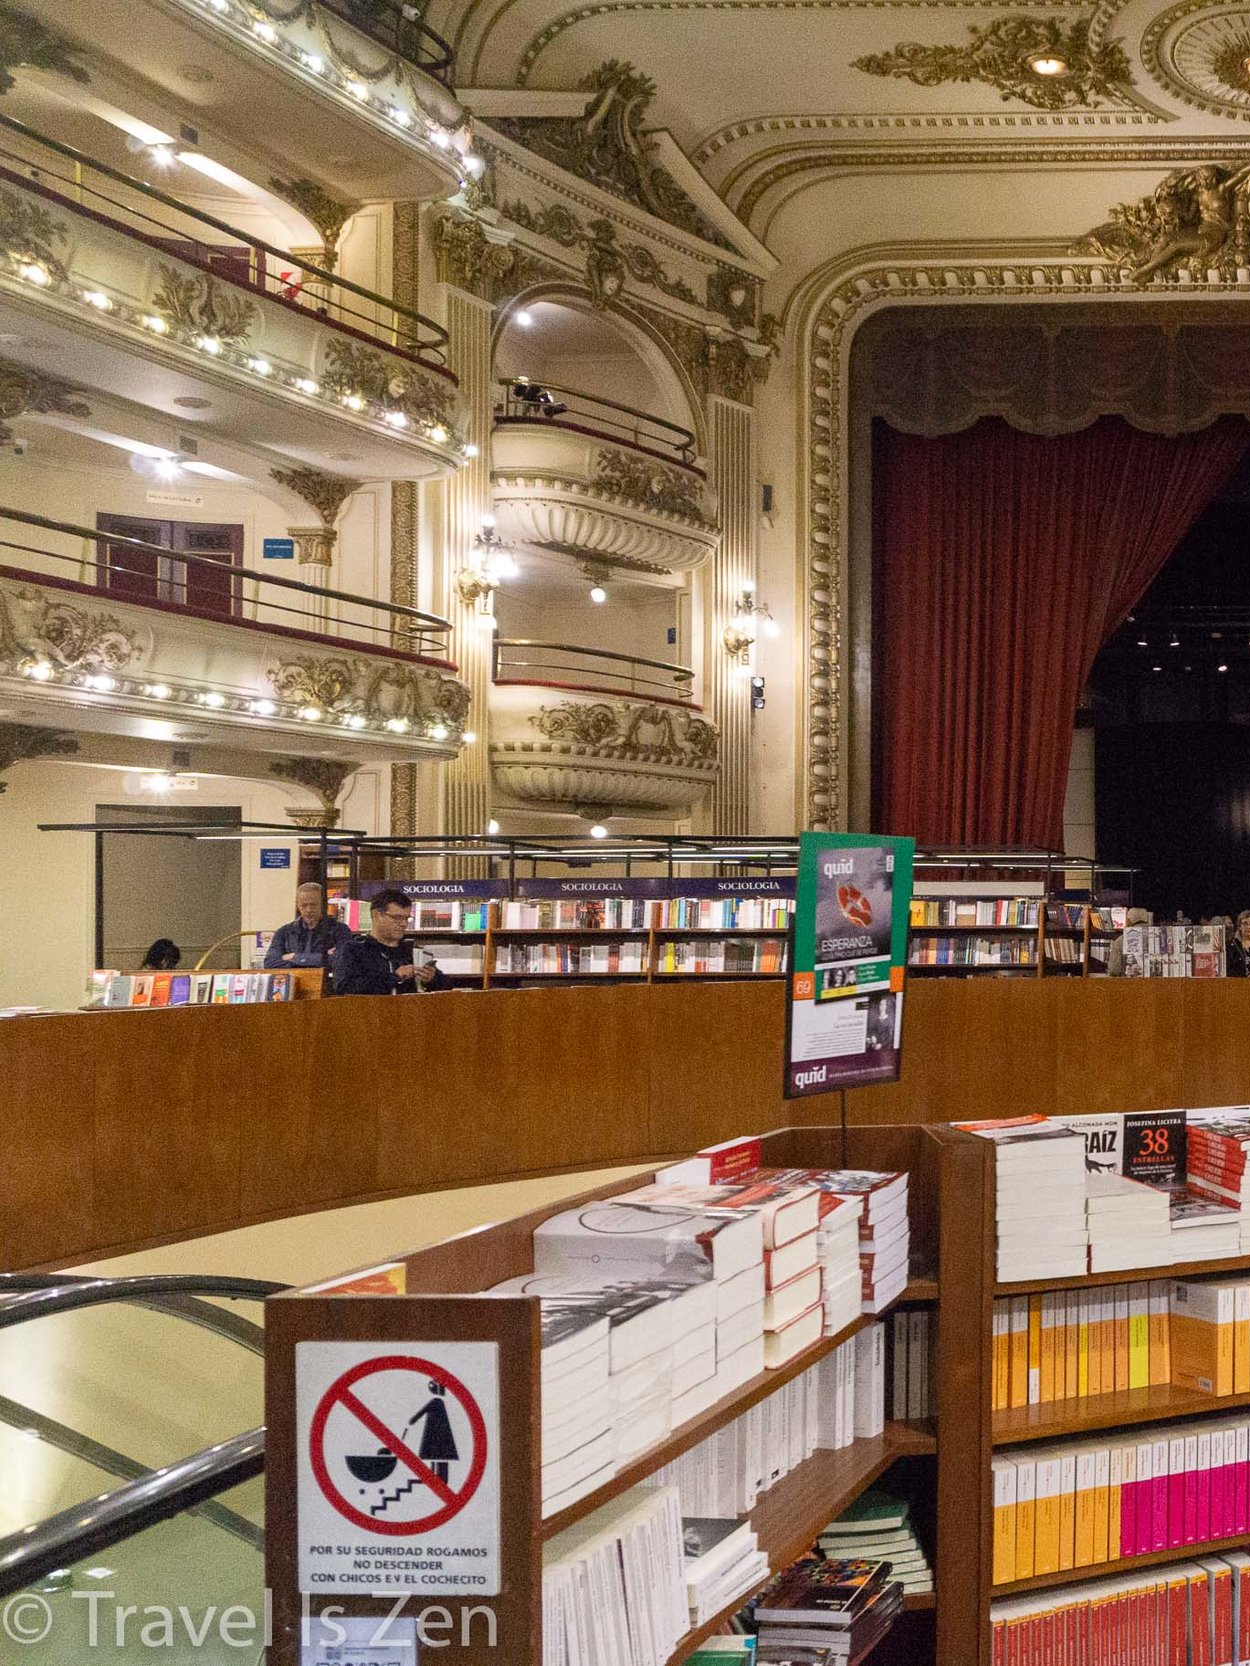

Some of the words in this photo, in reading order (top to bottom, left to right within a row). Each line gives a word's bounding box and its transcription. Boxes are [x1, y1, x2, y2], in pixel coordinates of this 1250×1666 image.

[823, 858, 854, 879] quid
[403, 884, 465, 894] SOCIOLOGIA
[561, 882, 623, 892] SOCIOLOGIA
[718, 881, 780, 891] SOCIOLOGIA
[821, 935, 873, 953] ESPERANZA
[795, 1065, 827, 1089] quid
[1139, 1128, 1169, 1156] 38
[309, 1545, 333, 1556] POR
[337, 1545, 352, 1556] SU
[355, 1546, 423, 1557] SEGURIDAD
[426, 1547, 488, 1558] ROGAMOS
[353, 1560, 371, 1570] NO
[374, 1560, 443, 1571] DESCENDER
[311, 1573, 336, 1584] CON
[339, 1573, 382, 1584] CHICOS
[404, 1575, 418, 1584] EL
[421, 1574, 487, 1585] COCHECITO
